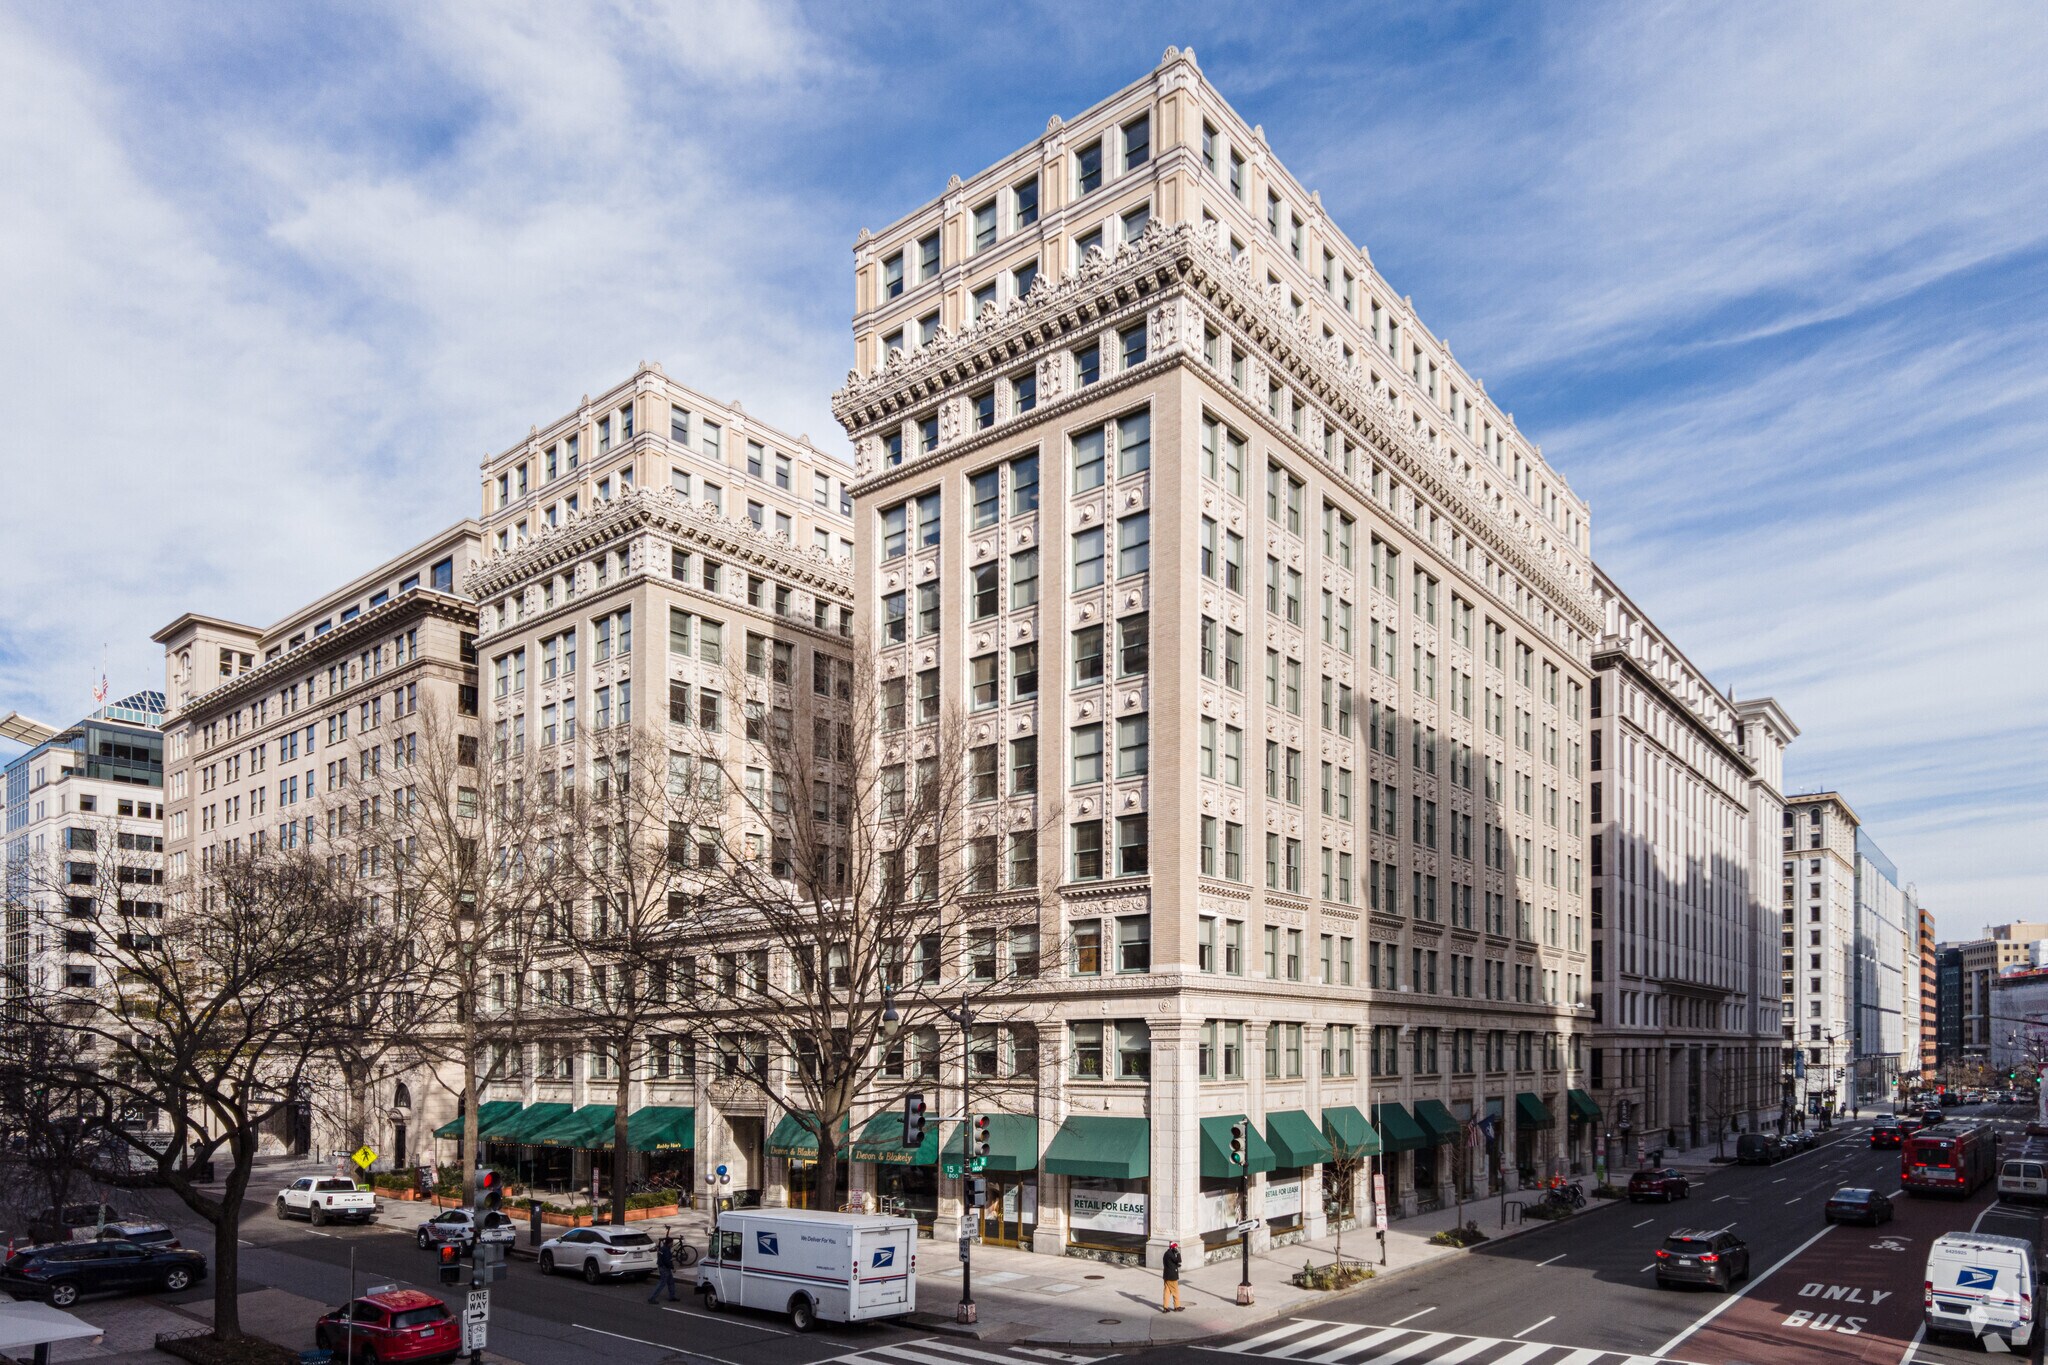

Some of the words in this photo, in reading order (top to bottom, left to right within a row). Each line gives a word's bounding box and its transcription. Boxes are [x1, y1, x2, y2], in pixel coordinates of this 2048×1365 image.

[770, 1146, 788, 1155] Devon
[789, 1147, 796, 1155] &
[856, 1151, 876, 1160] Devon
[878, 1152, 884, 1160] &
[886, 1153, 913, 1164] Blakely
[946, 1165, 954, 1173] 15
[1278, 1188, 1286, 1196] FOR
[1287, 1186, 1299, 1194] LEASE
[1074, 1199, 1100, 1210] RETAIL
[1101, 1202, 1118, 1211] FOR
[1119, 1203, 1144, 1214] LEASE
[437, 1228, 457, 1236] POLICE
[470, 1292, 487, 1301] ONE
[1798, 1283, 1893, 1305] ONLY
[470, 1301, 487, 1311] WAY
[1781, 1309, 1868, 1335] BUS
